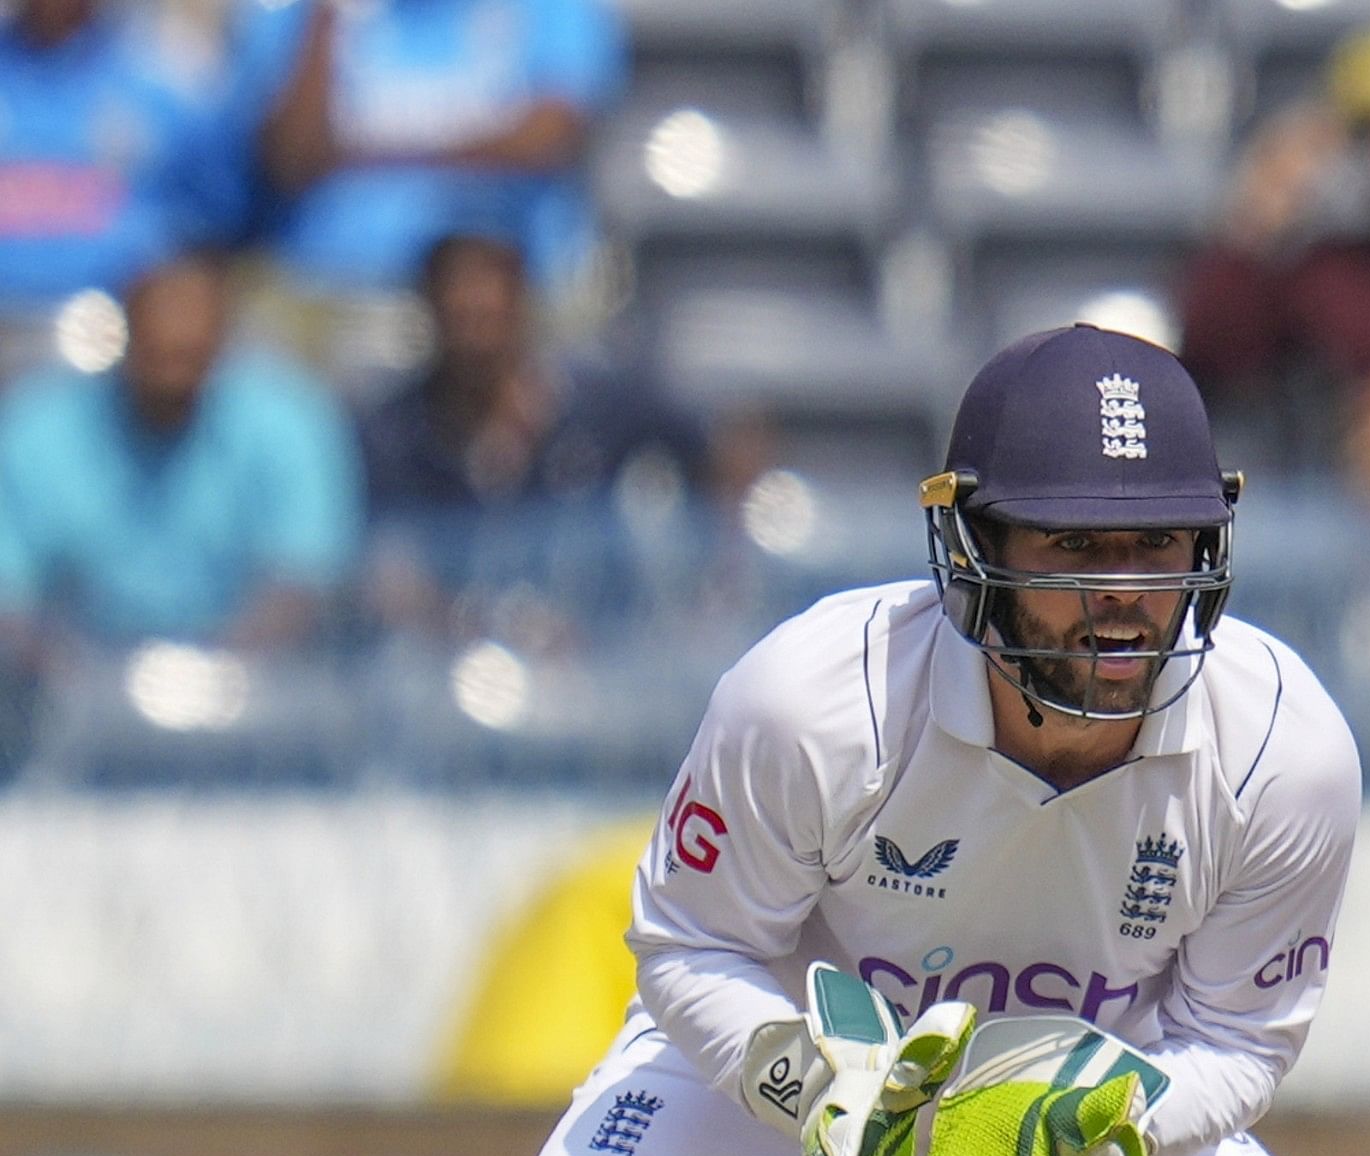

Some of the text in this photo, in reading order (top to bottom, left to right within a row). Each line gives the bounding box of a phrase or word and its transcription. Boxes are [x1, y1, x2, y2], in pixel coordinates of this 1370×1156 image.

[667, 773, 729, 875] IG
[866, 874, 948, 900] CASTORE
[1118, 922, 1157, 940] 689
[1253, 927, 1330, 990] cin
